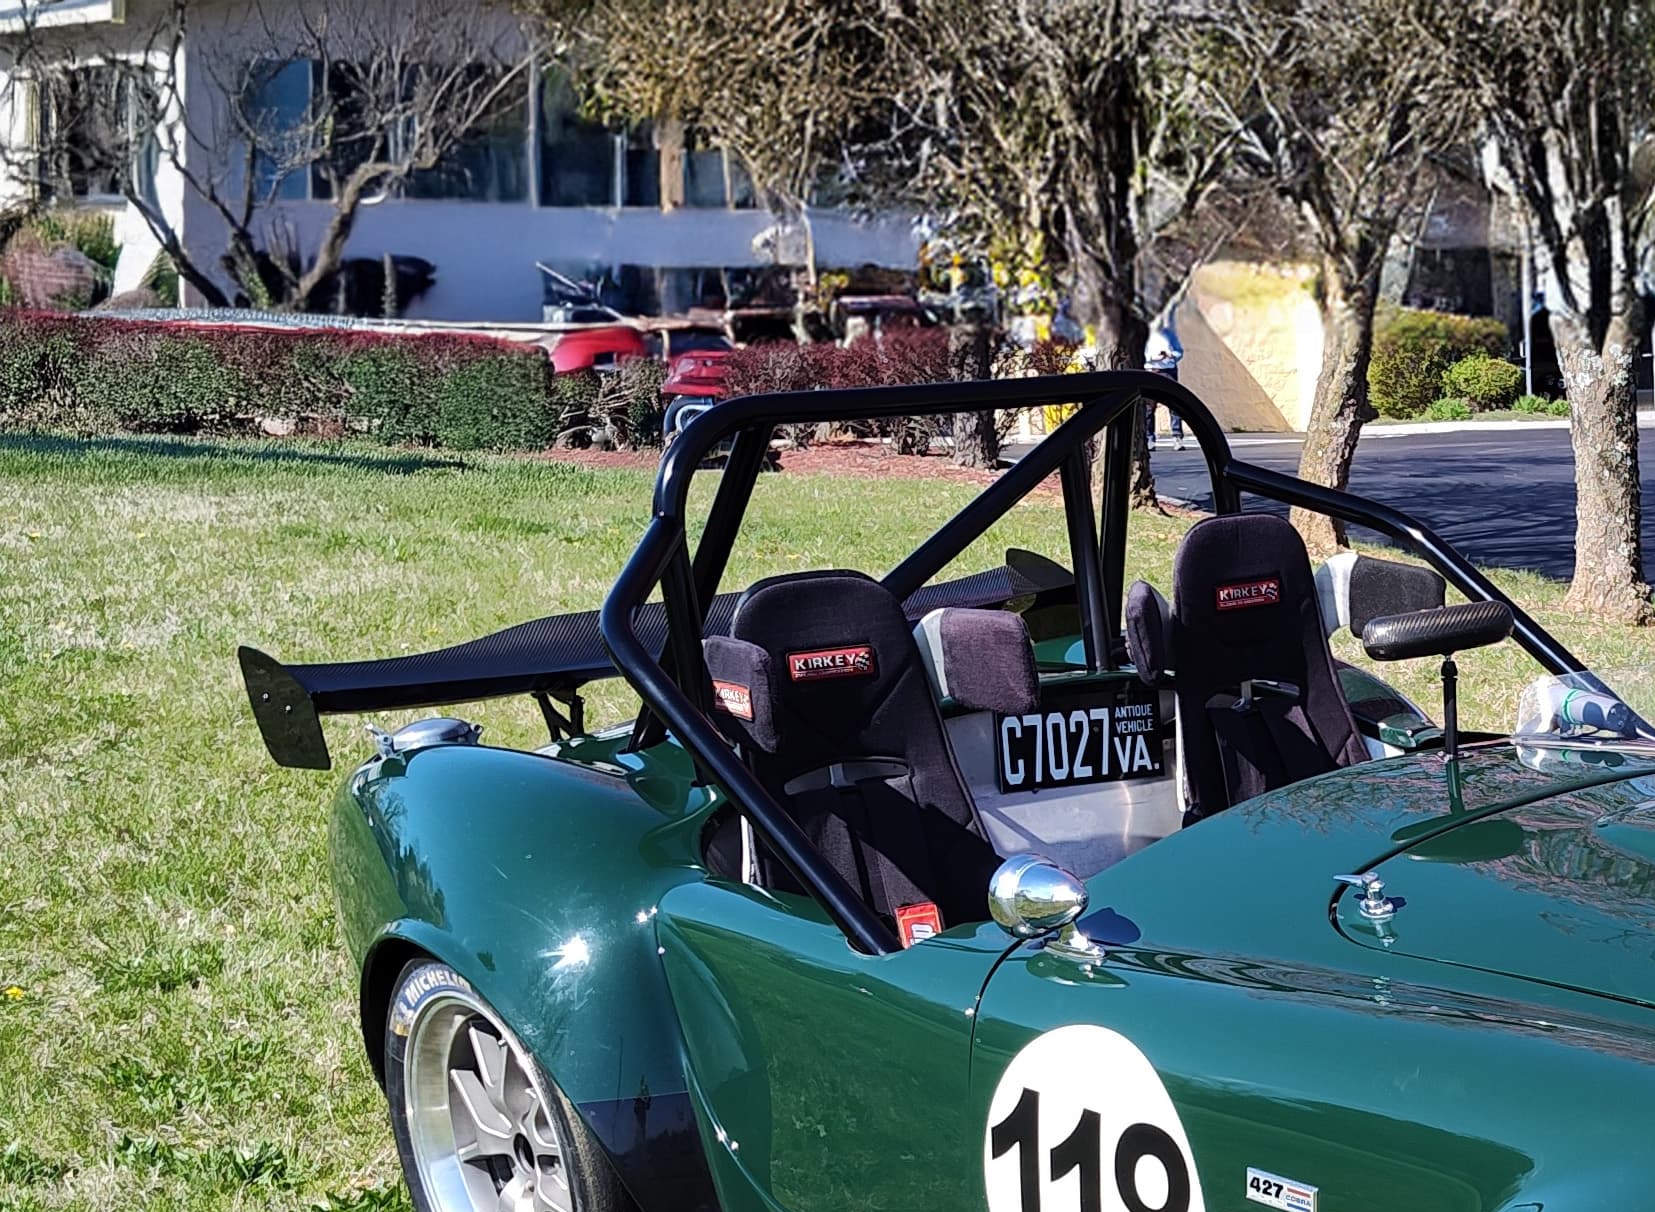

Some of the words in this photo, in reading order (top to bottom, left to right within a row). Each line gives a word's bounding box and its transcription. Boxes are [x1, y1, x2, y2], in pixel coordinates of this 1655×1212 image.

[1220, 584, 1267, 600] KIRKEY
[795, 653, 856, 670] KIRKEY
[1114, 704, 1153, 719] ANTIQUE
[1115, 719, 1154, 734] VEHICLE
[1001, 707, 1110, 785] C7027
[1113, 734, 1160, 774] VA.
[1249, 1177, 1284, 1199] 427
